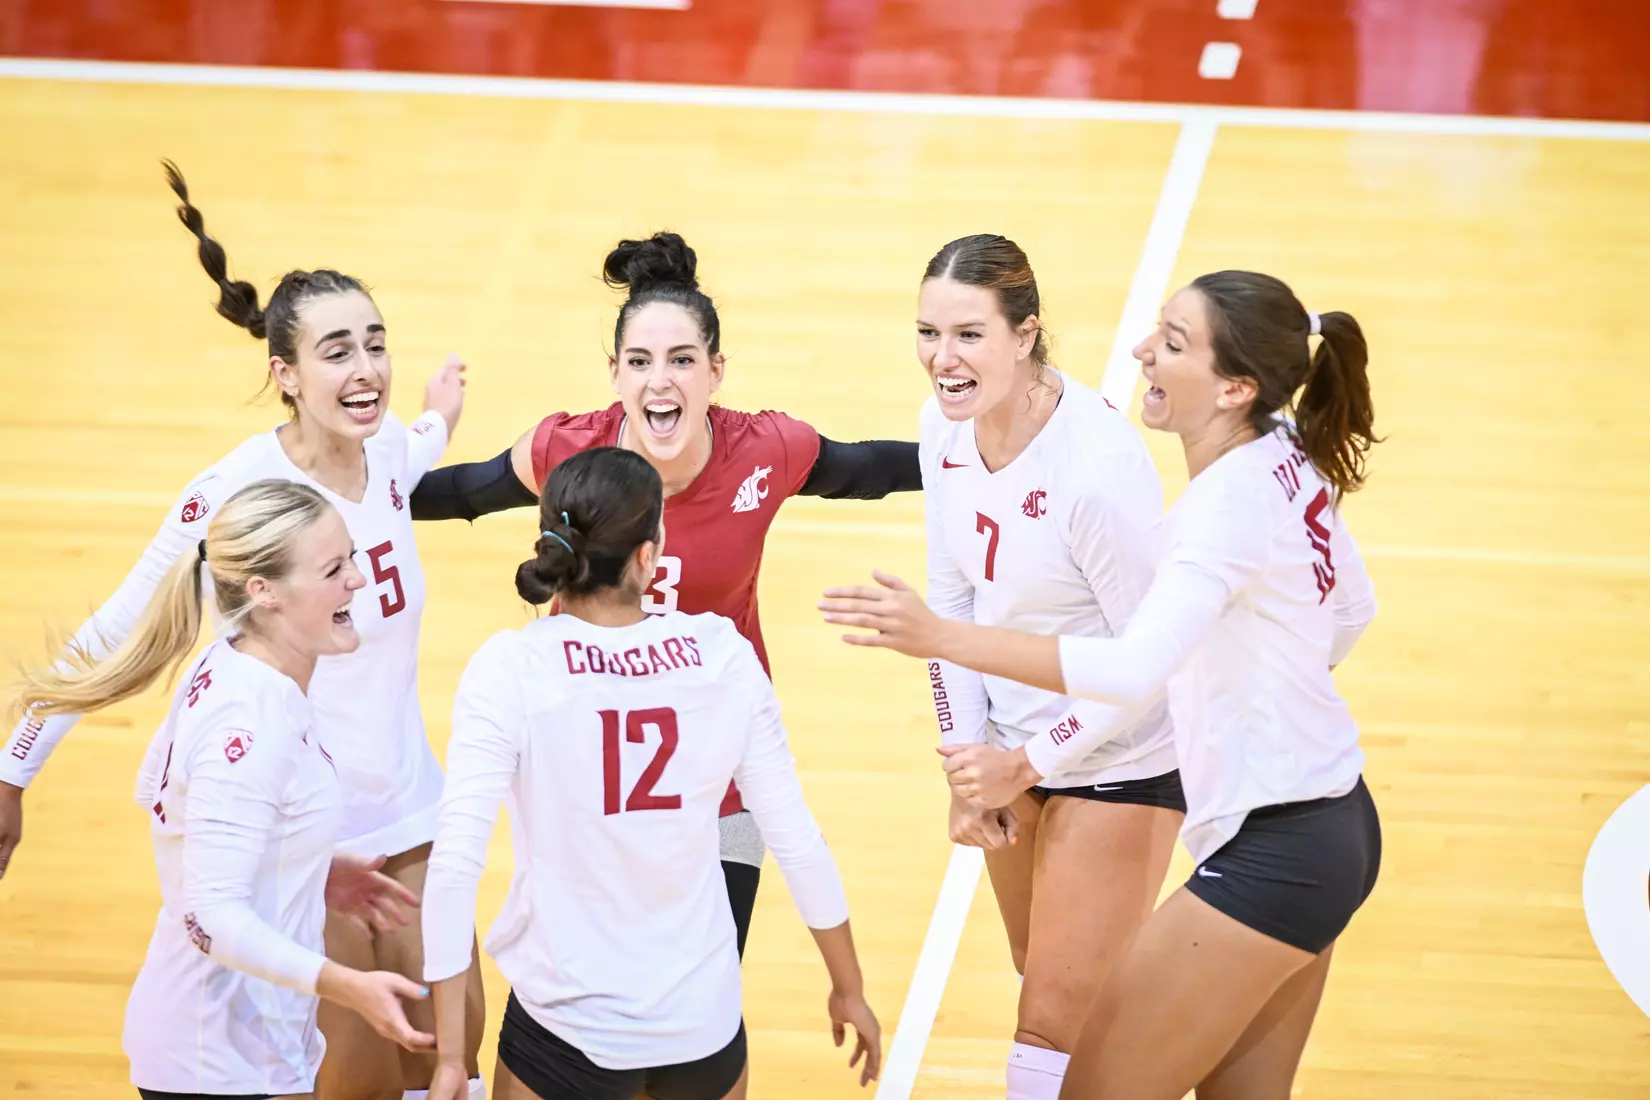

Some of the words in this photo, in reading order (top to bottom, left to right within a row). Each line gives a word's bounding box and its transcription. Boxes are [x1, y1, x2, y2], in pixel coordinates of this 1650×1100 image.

[365, 540, 406, 619] 5
[975, 510, 1000, 583] 7
[640, 555, 682, 615] 3
[563, 635, 703, 677] COUGARS
[928, 662, 954, 733] COUGARS
[1050, 713, 1084, 746] WSU
[594, 706, 682, 816] 12
